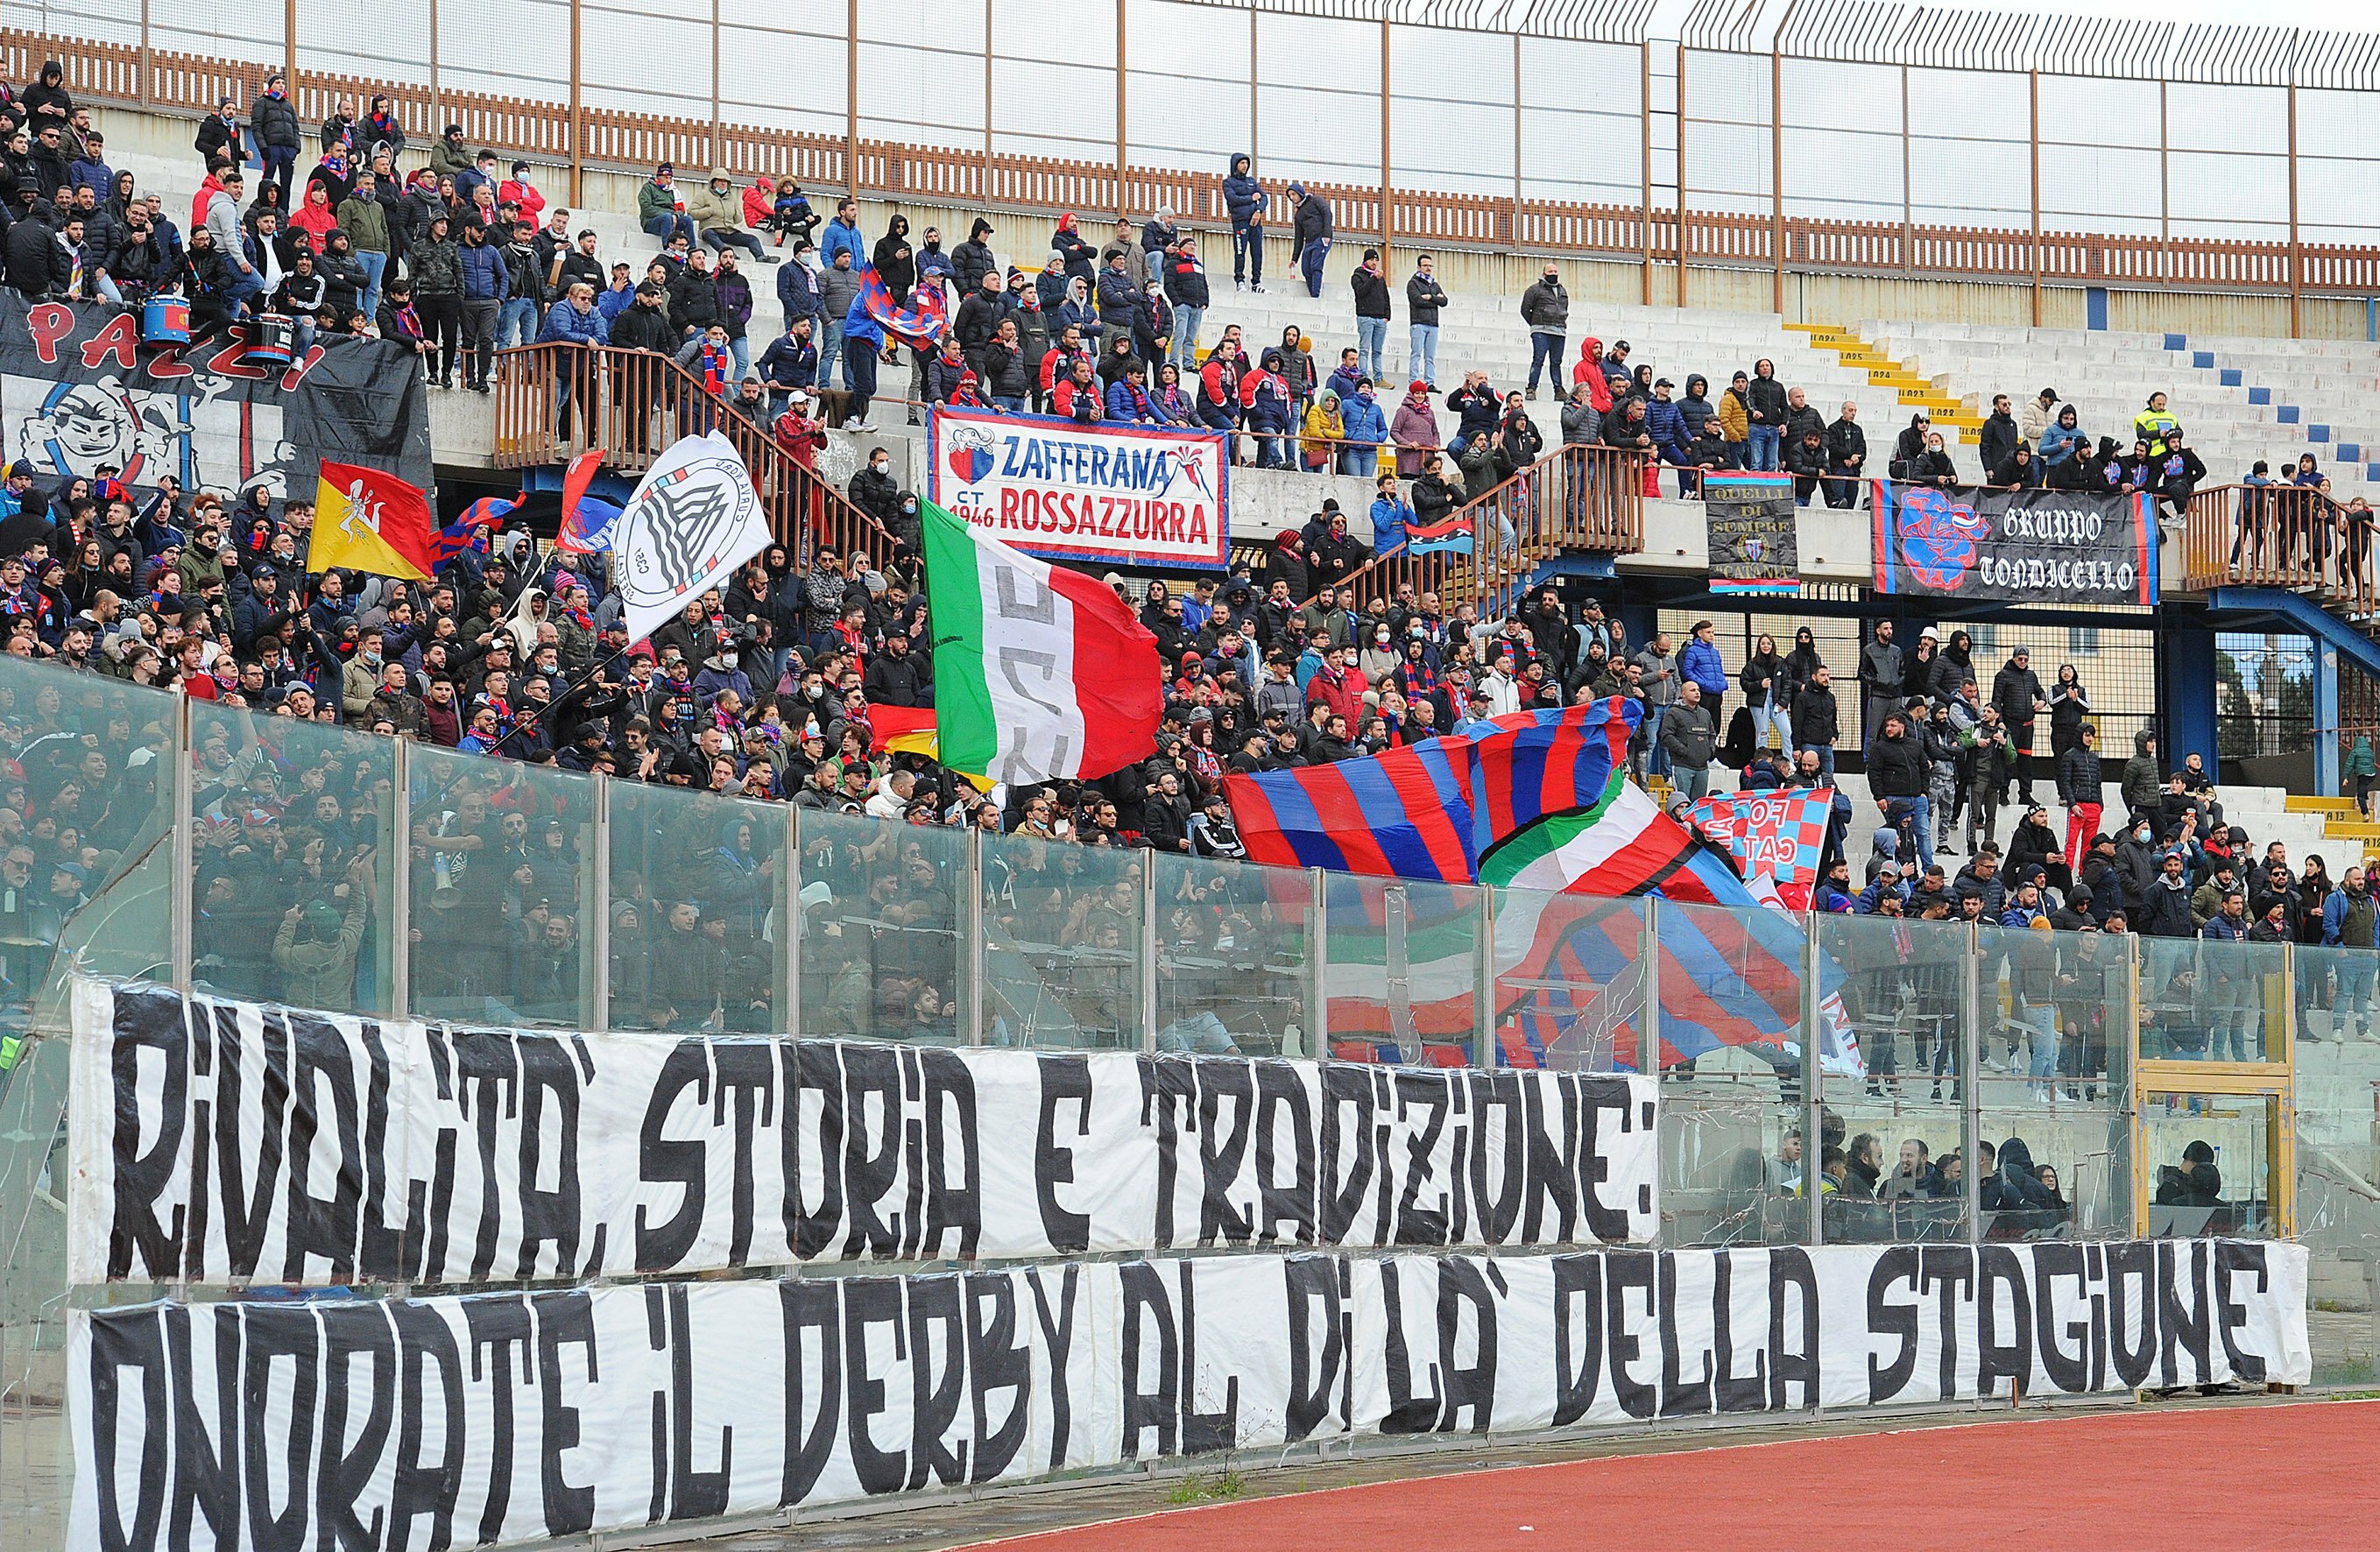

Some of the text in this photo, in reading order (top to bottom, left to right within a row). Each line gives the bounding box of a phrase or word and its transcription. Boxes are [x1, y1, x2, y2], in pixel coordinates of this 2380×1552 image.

[1002, 435, 1170, 491] ZAFFERANA
[957, 490, 984, 504] CT
[1714, 488, 1785, 501] QUELLI
[1741, 505, 1762, 517] DI
[950, 505, 994, 528] 1946
[1000, 488, 1209, 545] ROSSAZZURRA
[1713, 521, 1790, 533] SEMPRE
[2002, 506, 2102, 546] GRUPPO
[1979, 555, 2134, 591] TONDICELLO
[634, 1037, 980, 1274] STORIA
[1037, 1052, 1092, 1254] E
[1137, 1054, 1655, 1249] TRADIZIONE:
[646, 1282, 731, 1523] IL
[780, 1262, 1080, 1509] DERBY
[1119, 1259, 1238, 1460] AL
[1551, 1247, 1819, 1427] DELLA
[1867, 1238, 2269, 1403] STAGIONE
